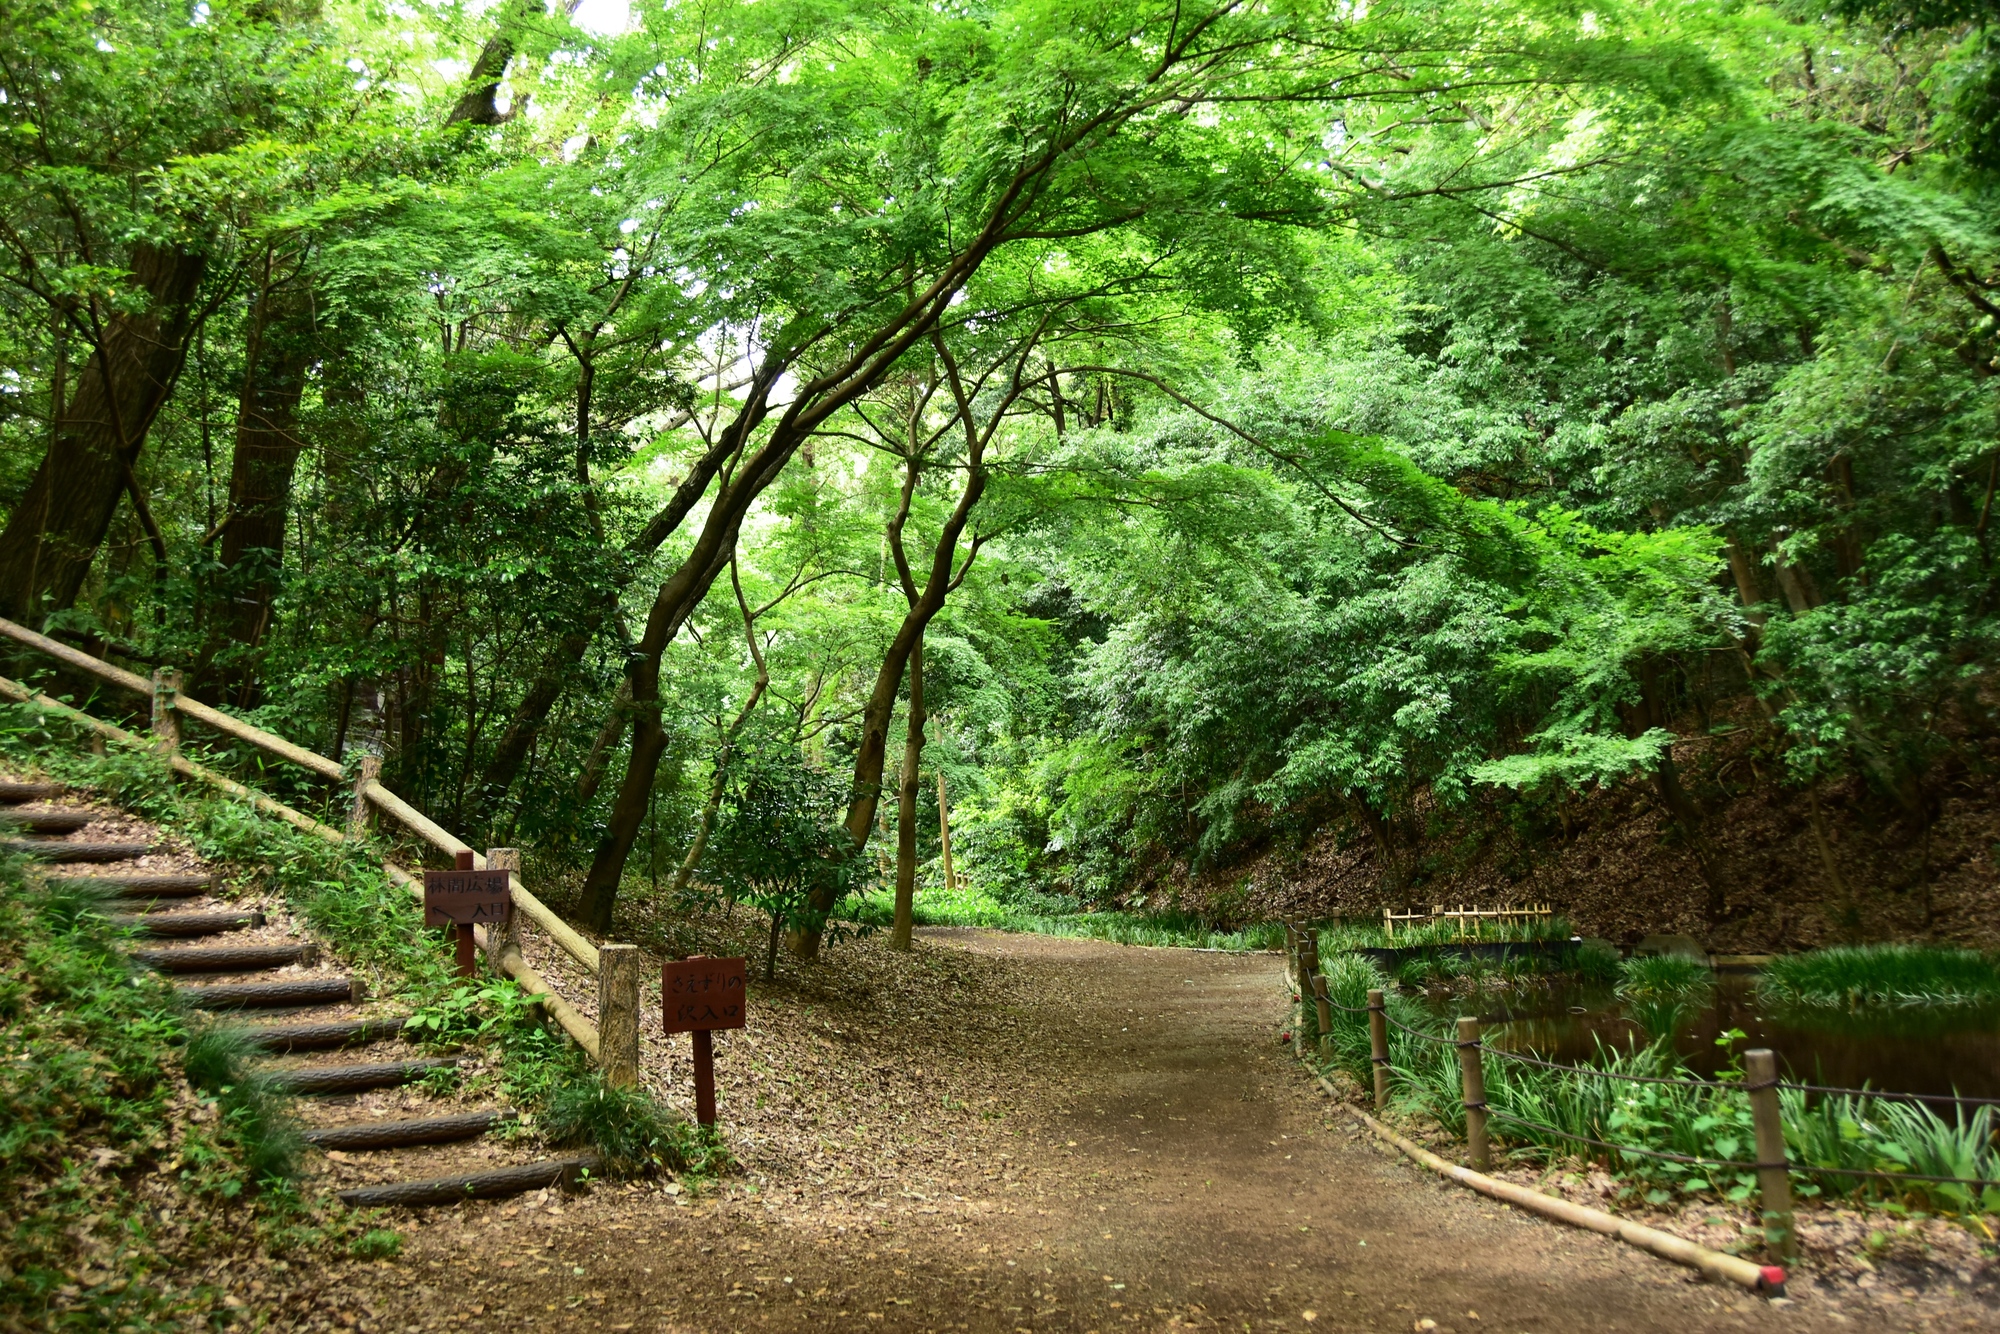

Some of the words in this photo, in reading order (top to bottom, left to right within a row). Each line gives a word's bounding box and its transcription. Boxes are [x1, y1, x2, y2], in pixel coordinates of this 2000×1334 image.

[428, 876, 503, 894] 林間広場
[472, 902, 503, 918] 入口
[673, 973, 741, 993] さえずりの
